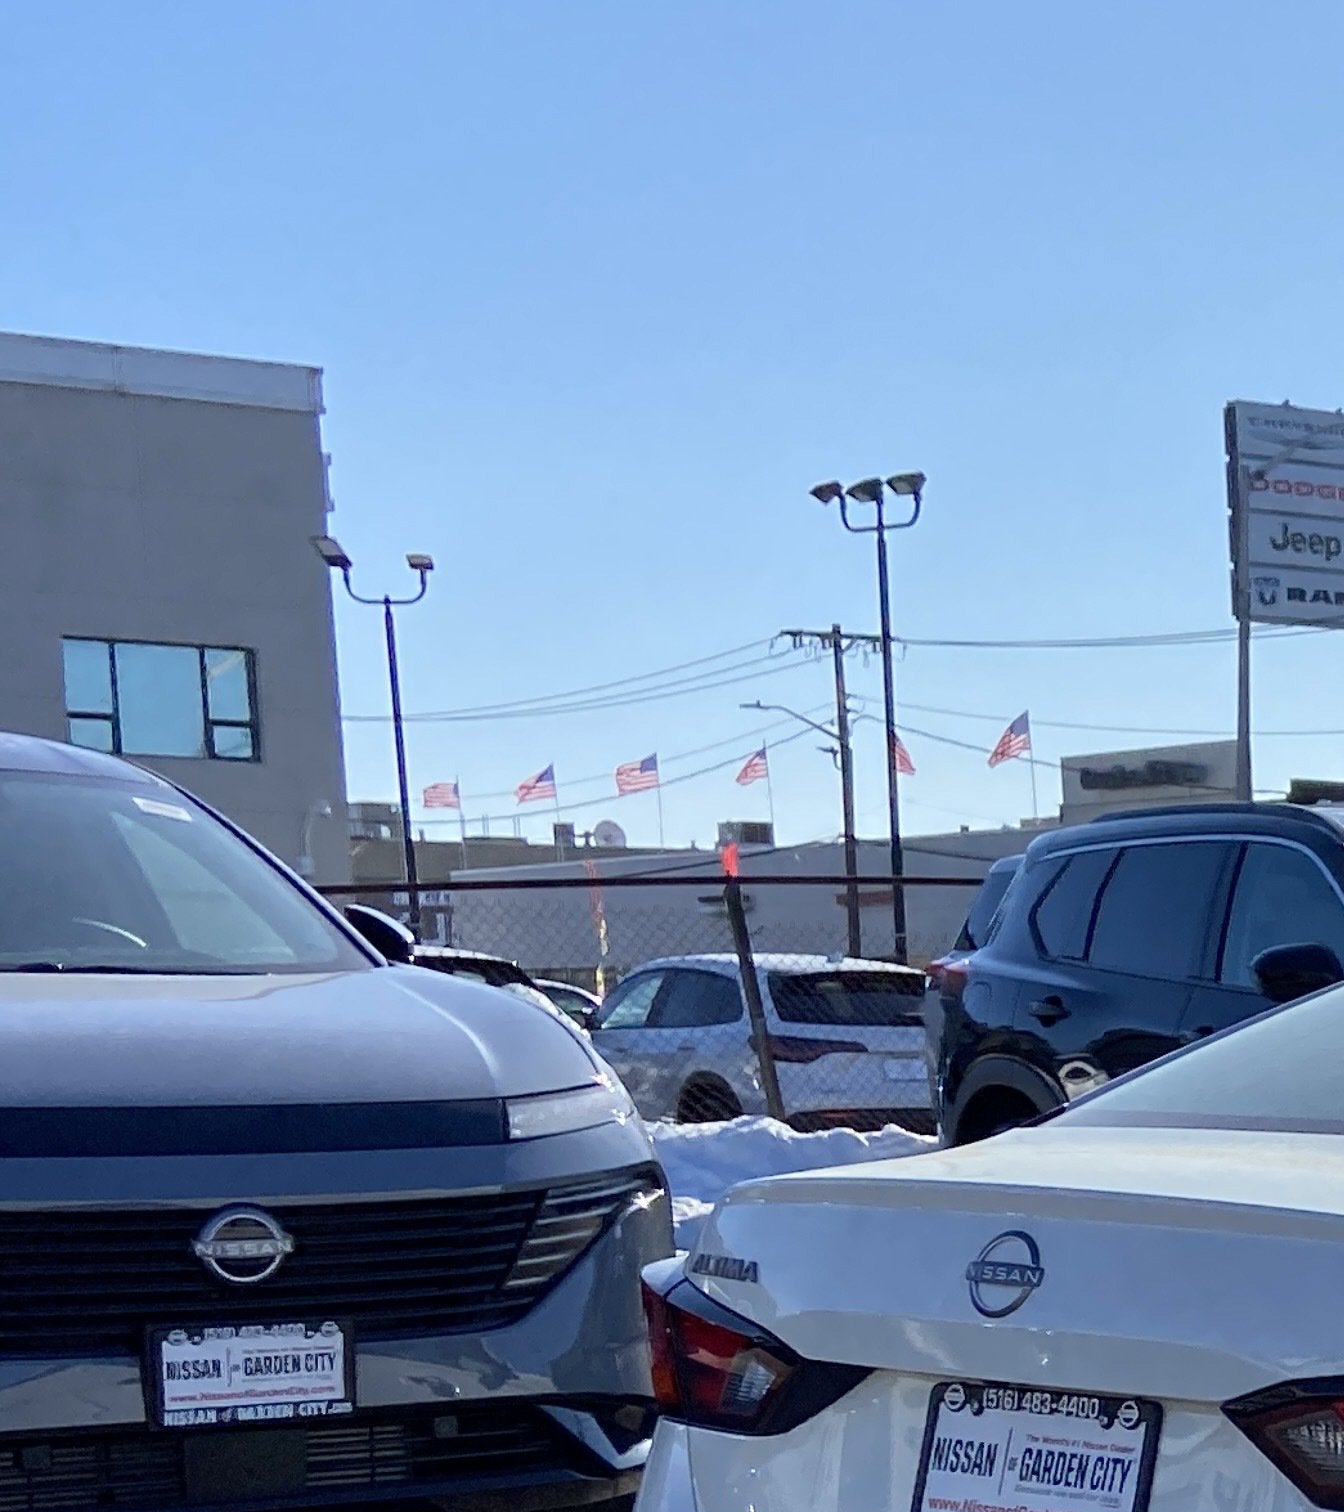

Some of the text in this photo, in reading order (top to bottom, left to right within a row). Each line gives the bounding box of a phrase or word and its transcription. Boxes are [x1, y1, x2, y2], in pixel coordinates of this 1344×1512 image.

[1270, 522, 1342, 560] Jeep
[195, 1239, 294, 1257] NISSAN
[692, 1254, 759, 1283] ALTIMA
[968, 1263, 1041, 1284] NSSAN
[166, 1359, 222, 1381] NISSAN
[244, 1352, 337, 1377] GARDEN CITY
[983, 1388, 1019, 1411] (516)
[931, 1436, 998, 1477] NISSAN
[1019, 1447, 1091, 1489] GARDEN
[1090, 1455, 1133, 1494] CITY
